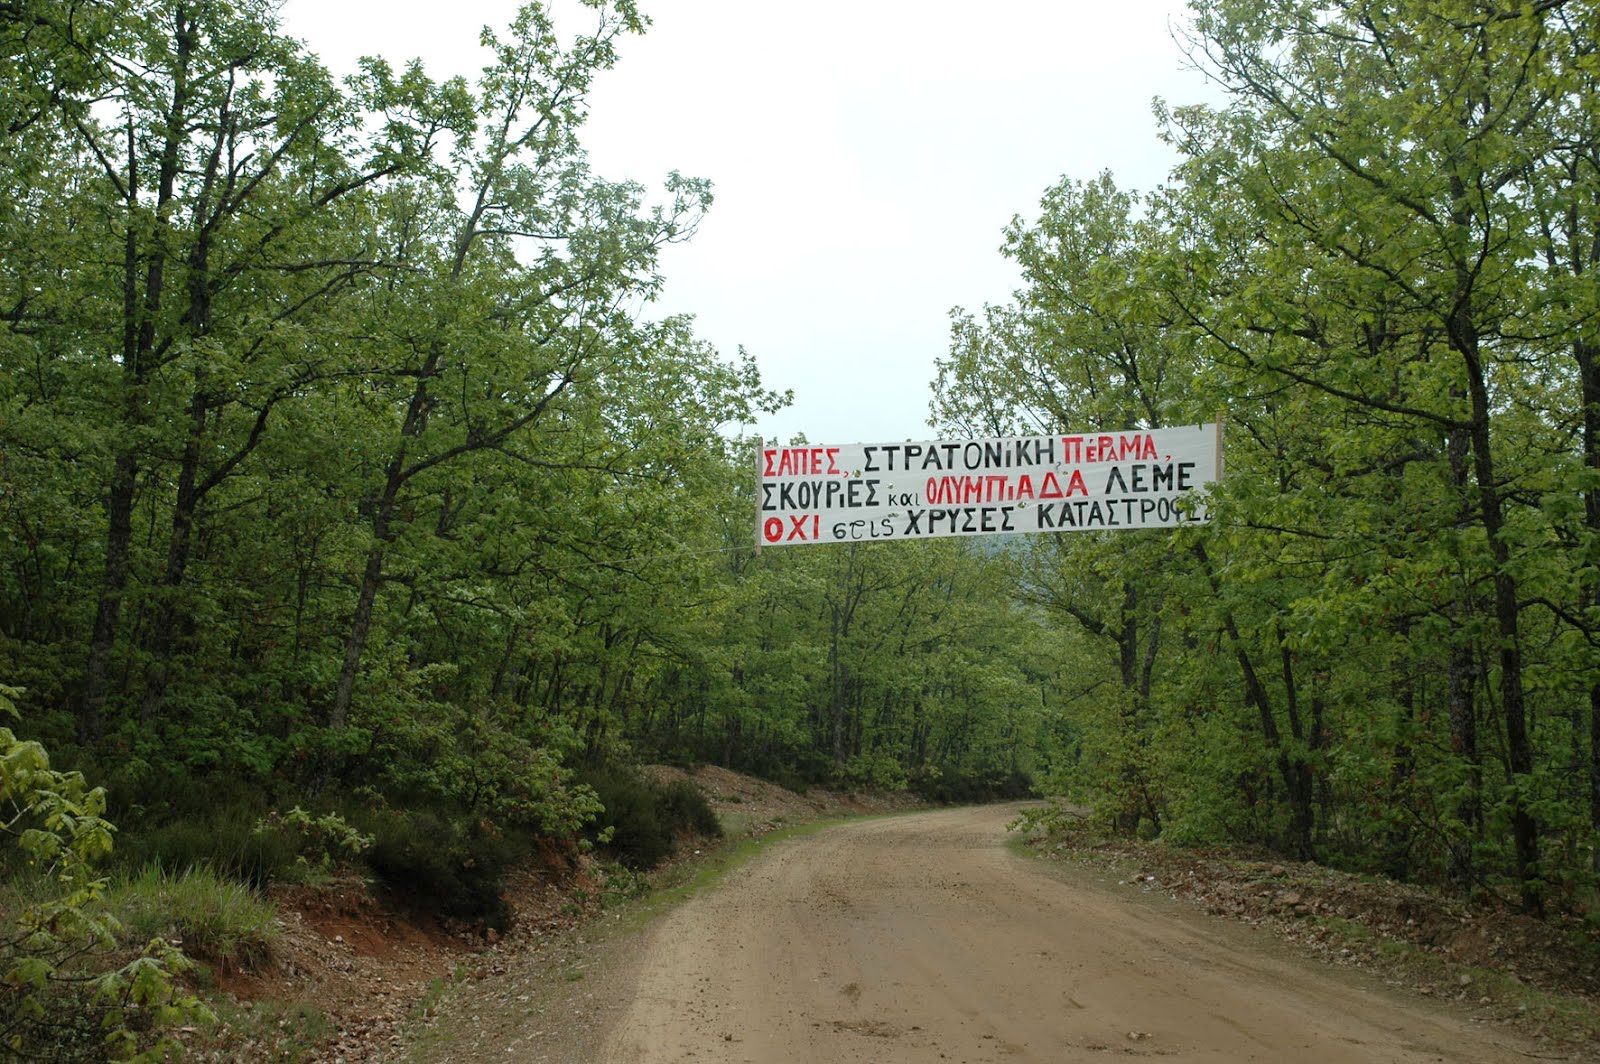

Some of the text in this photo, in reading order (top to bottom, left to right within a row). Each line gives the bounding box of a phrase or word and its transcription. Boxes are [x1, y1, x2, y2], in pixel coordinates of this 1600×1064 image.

[762, 462, 1196, 511] ΣΚΟΥΡΙΕΣ και ΟΛΥΜΠΙΑΔΑ ΛΕΜΕ
[763, 448, 849, 478] ΣΑΠΕΣ,
[764, 514, 819, 543] ΟΧΙ
[904, 507, 1014, 536] ΧΡΥΣΕΣ
[1038, 496, 1212, 529] ΚΑΤΑΣΤΡΟΦ
